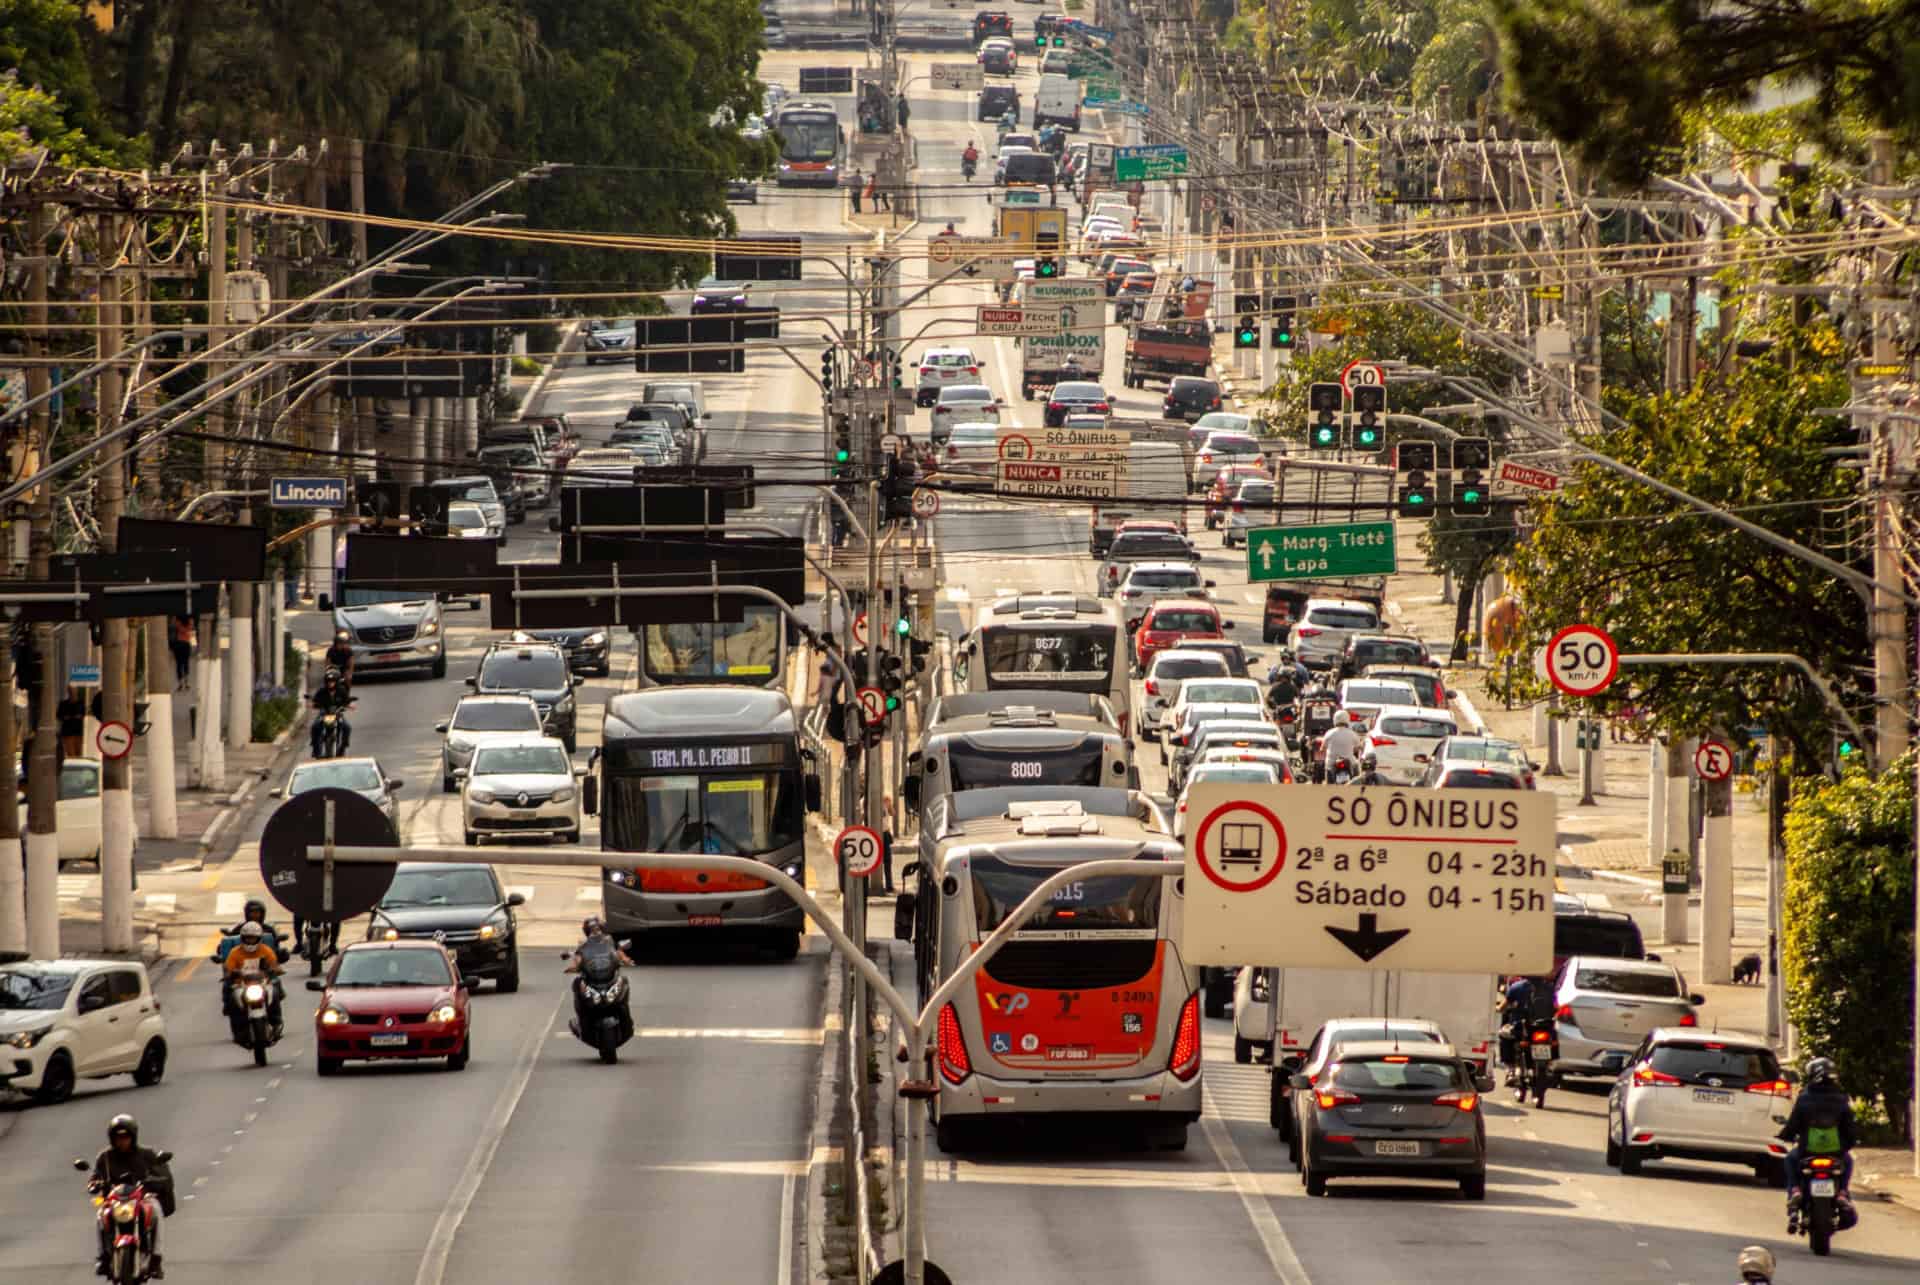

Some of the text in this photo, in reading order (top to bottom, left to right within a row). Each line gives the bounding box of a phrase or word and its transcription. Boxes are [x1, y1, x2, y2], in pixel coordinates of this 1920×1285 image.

[984, 312, 1056, 321] NUNCA FECHE
[1350, 369, 1376, 385] 50
[1068, 429, 1117, 444] ÔNIBUS
[1008, 466, 1057, 480] NUNCA
[1066, 469, 1109, 481] FECHE
[1506, 465, 1552, 489] NUNCA
[275, 483, 341, 500] Lincoln
[1018, 484, 1110, 498] CRUZAMENTO
[1283, 530, 1385, 552] Marg. Tietê
[1284, 558, 1328, 573] Lapa
[1560, 642, 1606, 670] 50
[1568, 671, 1599, 680] km/h
[652, 749, 680, 768] TERM.
[1011, 762, 1042, 777] 8000
[1327, 787, 1519, 830] SÓ ÔNIBUS
[843, 838, 874, 858] 50
[1296, 847, 1324, 871] 2ª
[1334, 852, 1349, 871] a
[1360, 848, 1388, 872] 6ª
[1427, 851, 1463, 874] 04
[1491, 853, 1546, 877] 23h
[1295, 881, 1407, 907] Sábado
[1427, 886, 1462, 909] 04
[1493, 888, 1546, 911] 15h
[1125, 1024, 1141, 1032] 156
